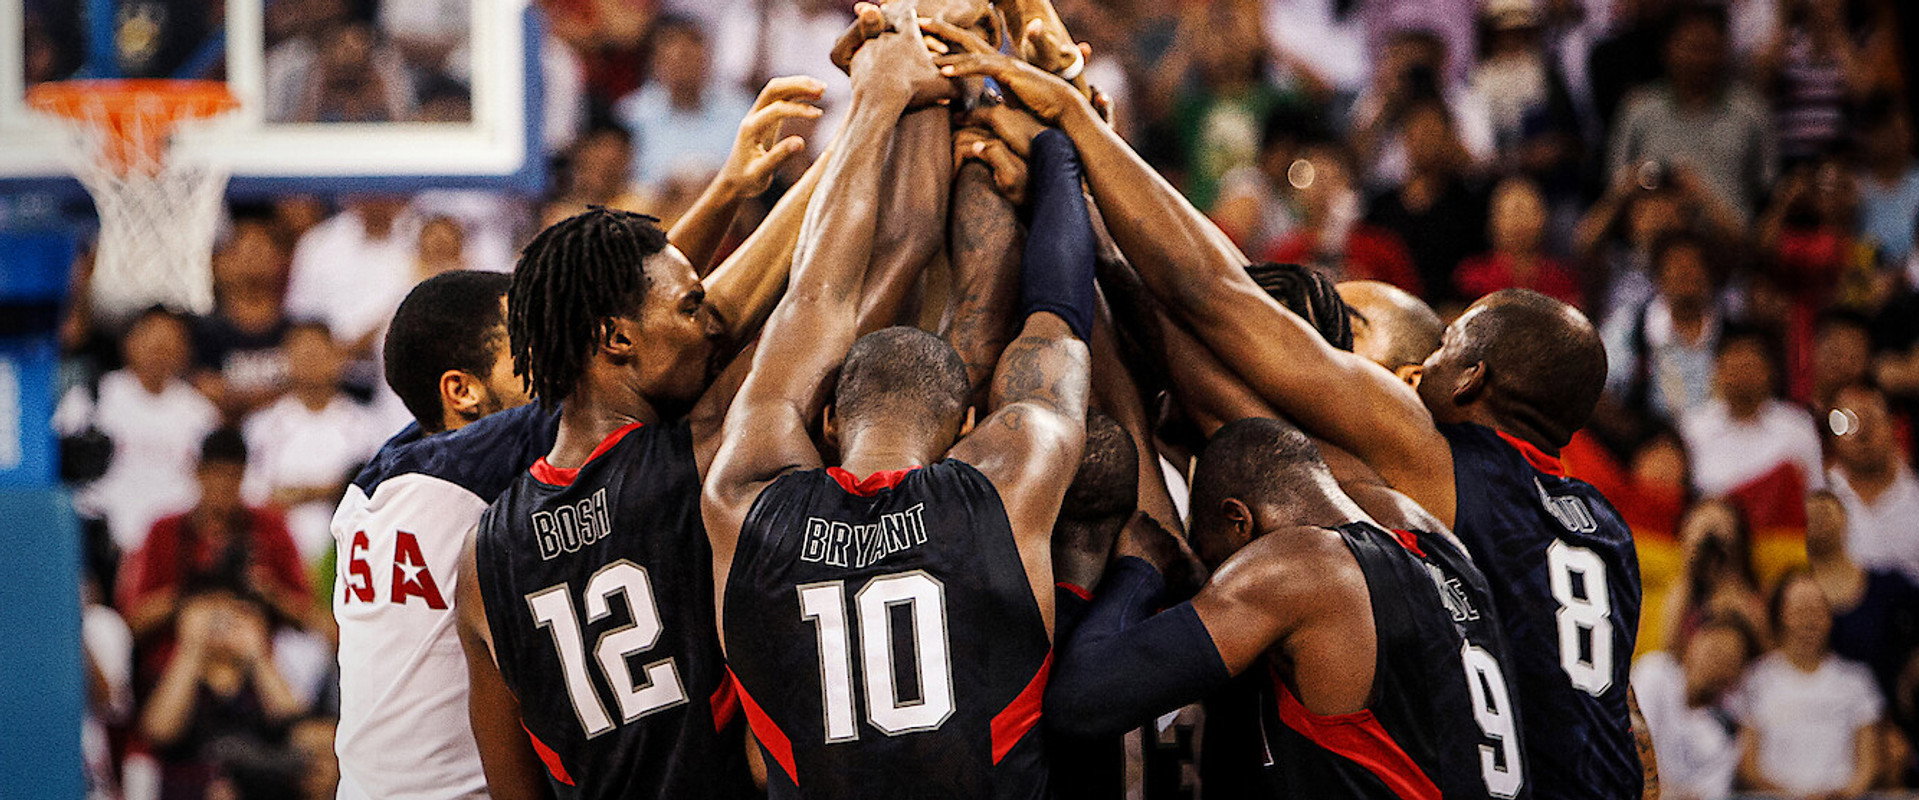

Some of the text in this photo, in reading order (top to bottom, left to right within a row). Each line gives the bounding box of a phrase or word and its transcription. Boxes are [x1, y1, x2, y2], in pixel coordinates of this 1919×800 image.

[344, 529, 449, 610] SA
[531, 487, 612, 561] BOSH
[800, 502, 928, 568] BRYANT
[524, 558, 690, 740] 12
[796, 568, 957, 745] 10
[1546, 537, 1614, 698] 8
[1460, 638, 1524, 800] 9
